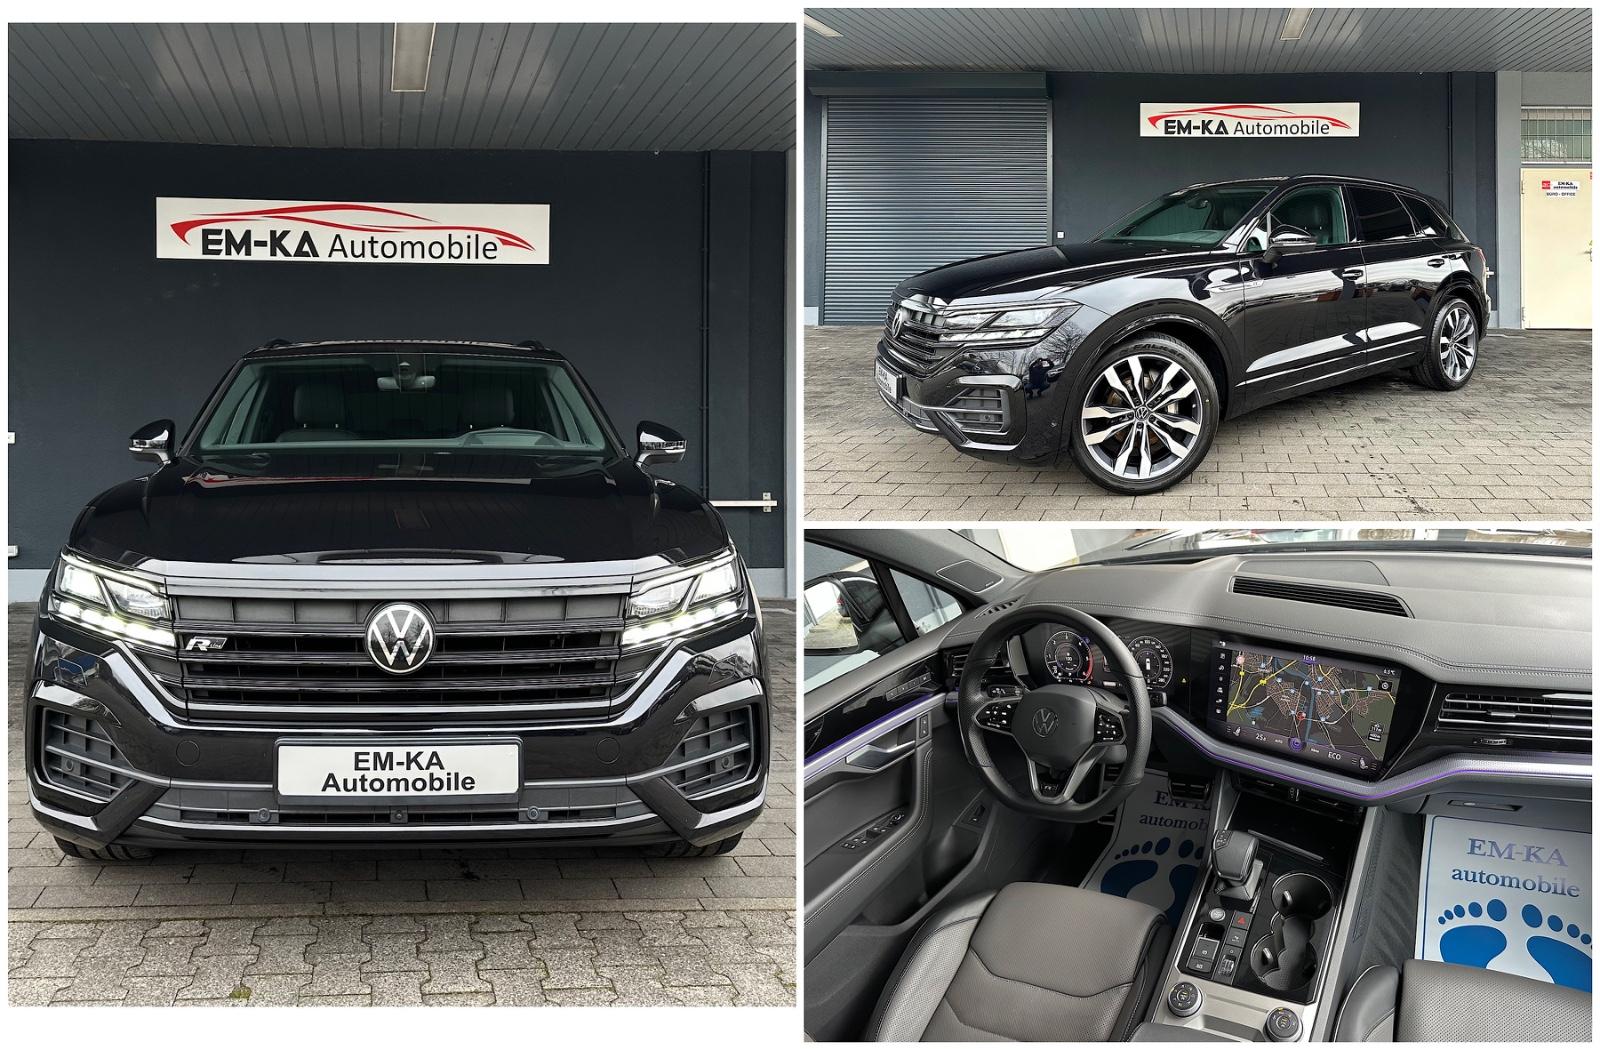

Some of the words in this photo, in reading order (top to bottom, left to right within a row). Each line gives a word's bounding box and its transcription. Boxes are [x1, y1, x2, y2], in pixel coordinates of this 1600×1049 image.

[1164, 119, 1229, 135] EM-KA
[1233, 120, 1330, 135] Automobile
[201, 228, 320, 258] EM-KA
[327, 232, 499, 261] Automobile
[353, 750, 446, 771] EM-KA
[1327, 751, 1342, 761] ECO
[321, 771, 477, 793] Automobile
[1466, 837, 1569, 867] EM-KA
[1451, 868, 1581, 898] automobile
